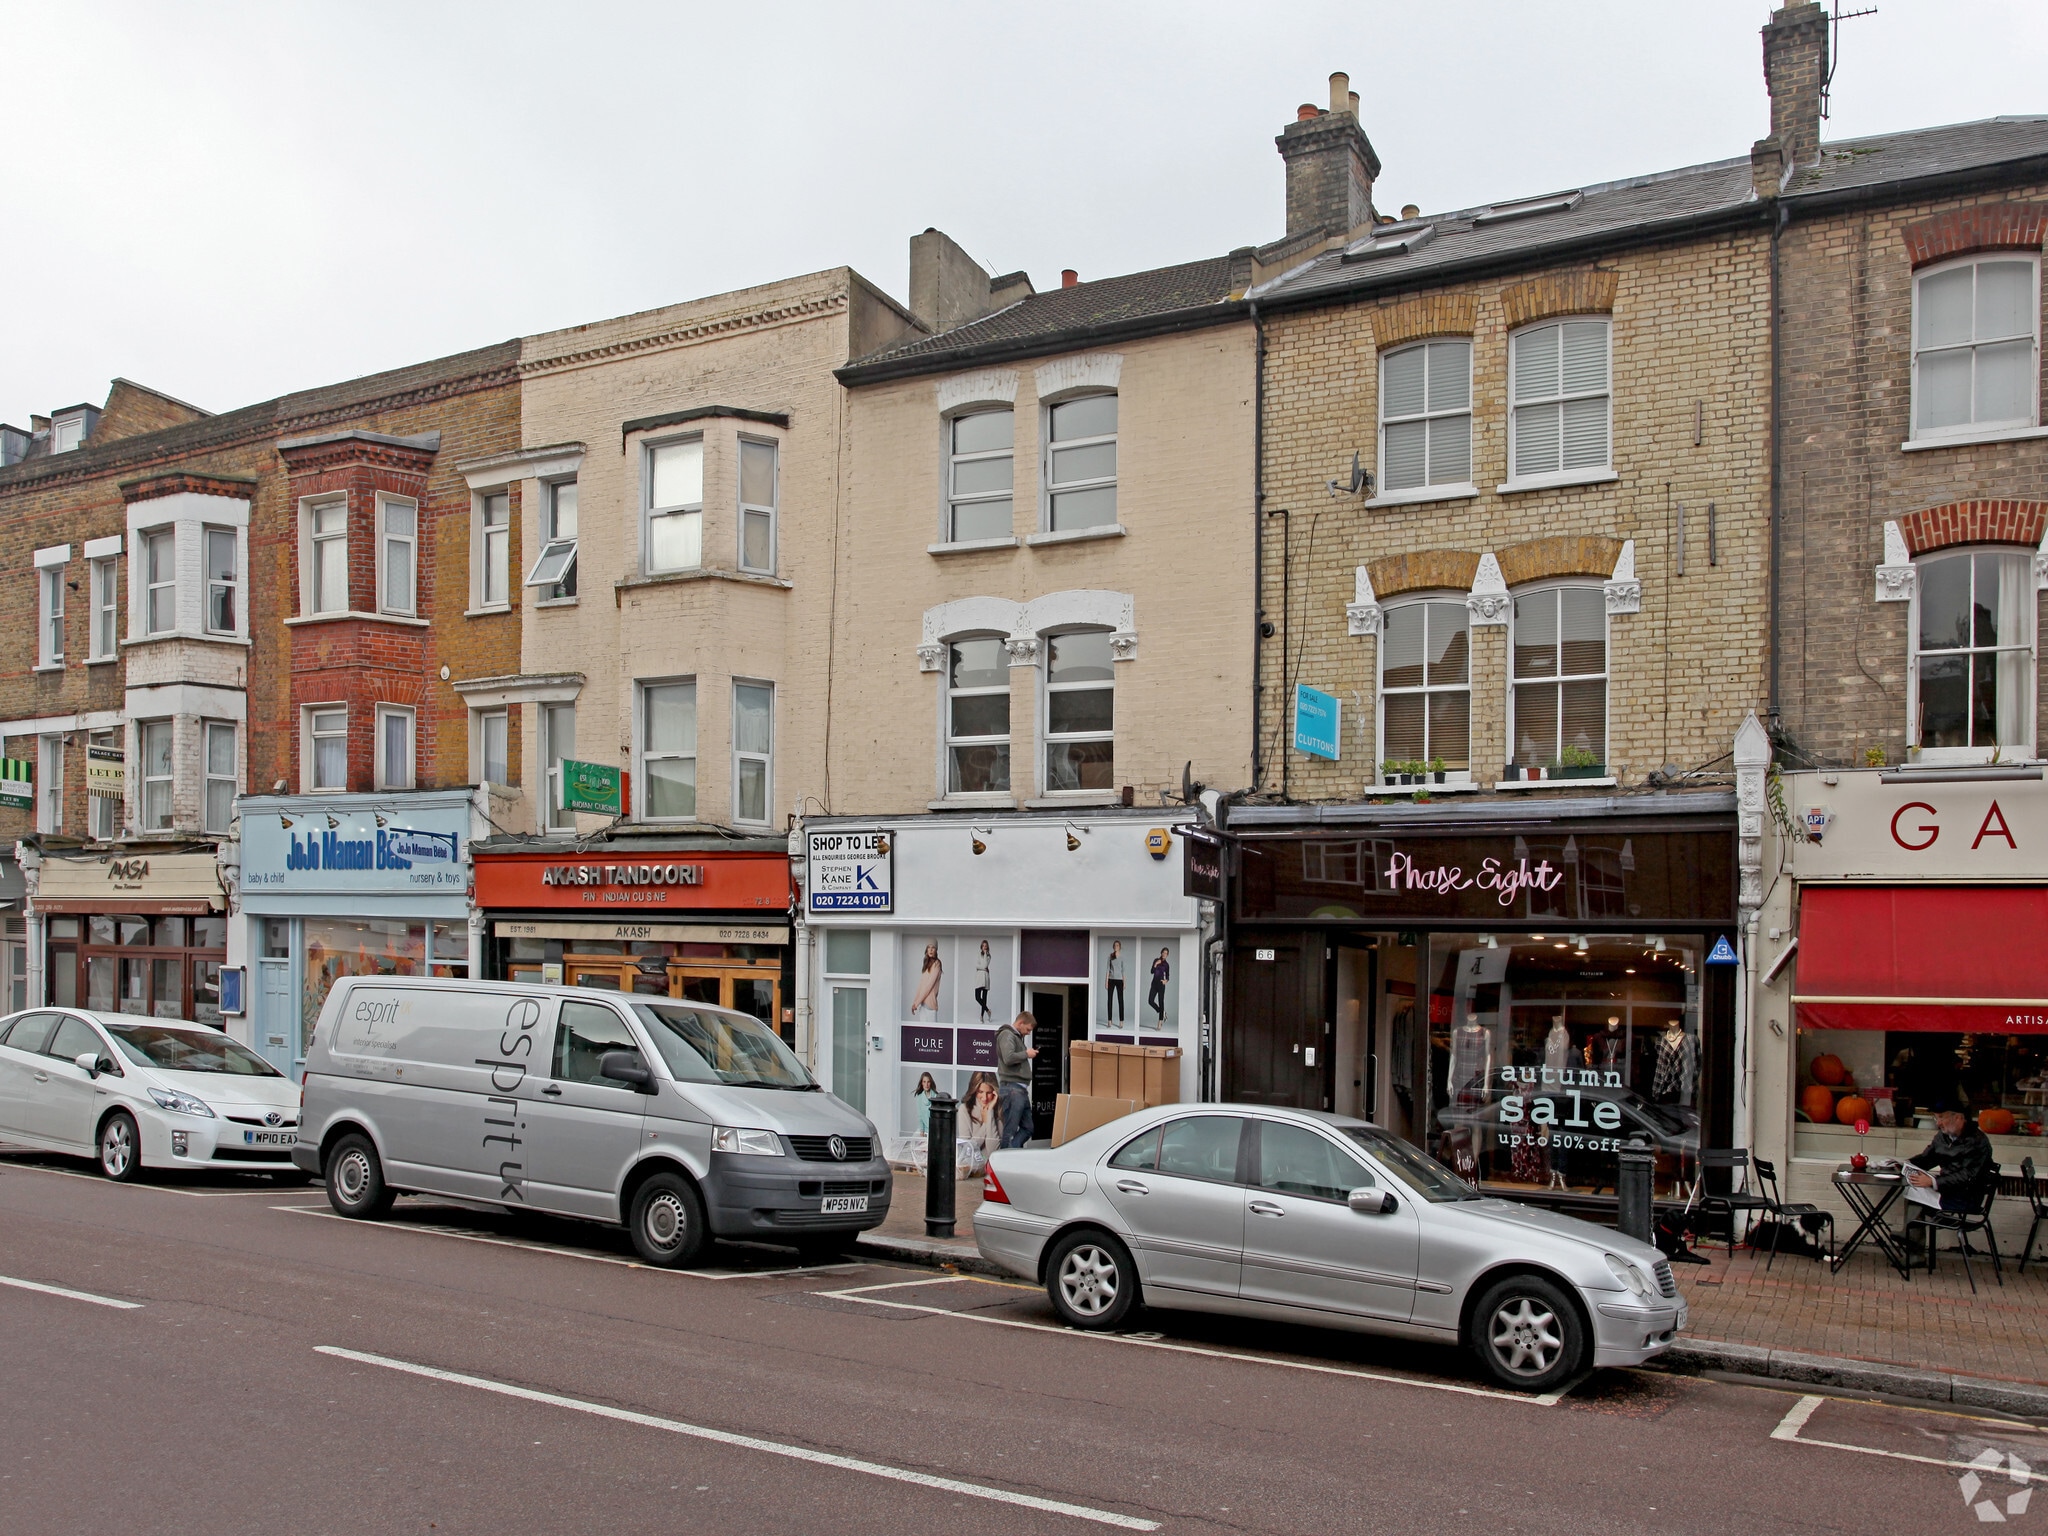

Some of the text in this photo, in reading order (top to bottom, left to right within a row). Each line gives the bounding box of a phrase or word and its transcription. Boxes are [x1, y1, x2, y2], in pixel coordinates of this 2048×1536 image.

[1300, 690, 1318, 703] FOR SALE
[1297, 733, 1335, 753] CLUTTONS
[90, 768, 111, 777] LET
[571, 800, 619, 813] INDIAN CUISINE
[1807, 815, 1825, 825] APT
[813, 836, 843, 851] SHOP
[846, 836, 861, 850] TO
[1150, 837, 1162, 845] ADT
[287, 832, 319, 871] JoJo
[322, 831, 374, 870] Maman
[397, 842, 447, 858] JoJo Maman Bébé
[107, 860, 150, 880] MASA
[542, 864, 698, 886] AKASH TANDOORI
[821, 865, 852, 873] STEPHEN
[248, 872, 285, 885] baby & child
[409, 871, 460, 885] nursery & toys
[821, 873, 852, 883] KANE
[1384, 852, 1563, 906] Phase Eight
[602, 892, 630, 902] INDIAN
[816, 895, 886, 905] 020 7224 0101
[615, 927, 651, 938] AKASH
[719, 930, 732, 938] 020
[734, 930, 750, 938] 7228
[1258, 950, 1273, 959] 66
[355, 998, 400, 1035] esprit
[914, 1037, 944, 1049] PURE
[1500, 1063, 1623, 1088] autumn
[475, 998, 541, 1202] esprit uk
[1036, 1101, 1055, 1111] PURE
[1499, 1089, 1622, 1130] sale
[256, 1133, 278, 1143] WP10
[1498, 1133, 1621, 1153] up to 50% off
[826, 1197, 865, 1211] WP59 NVZ
